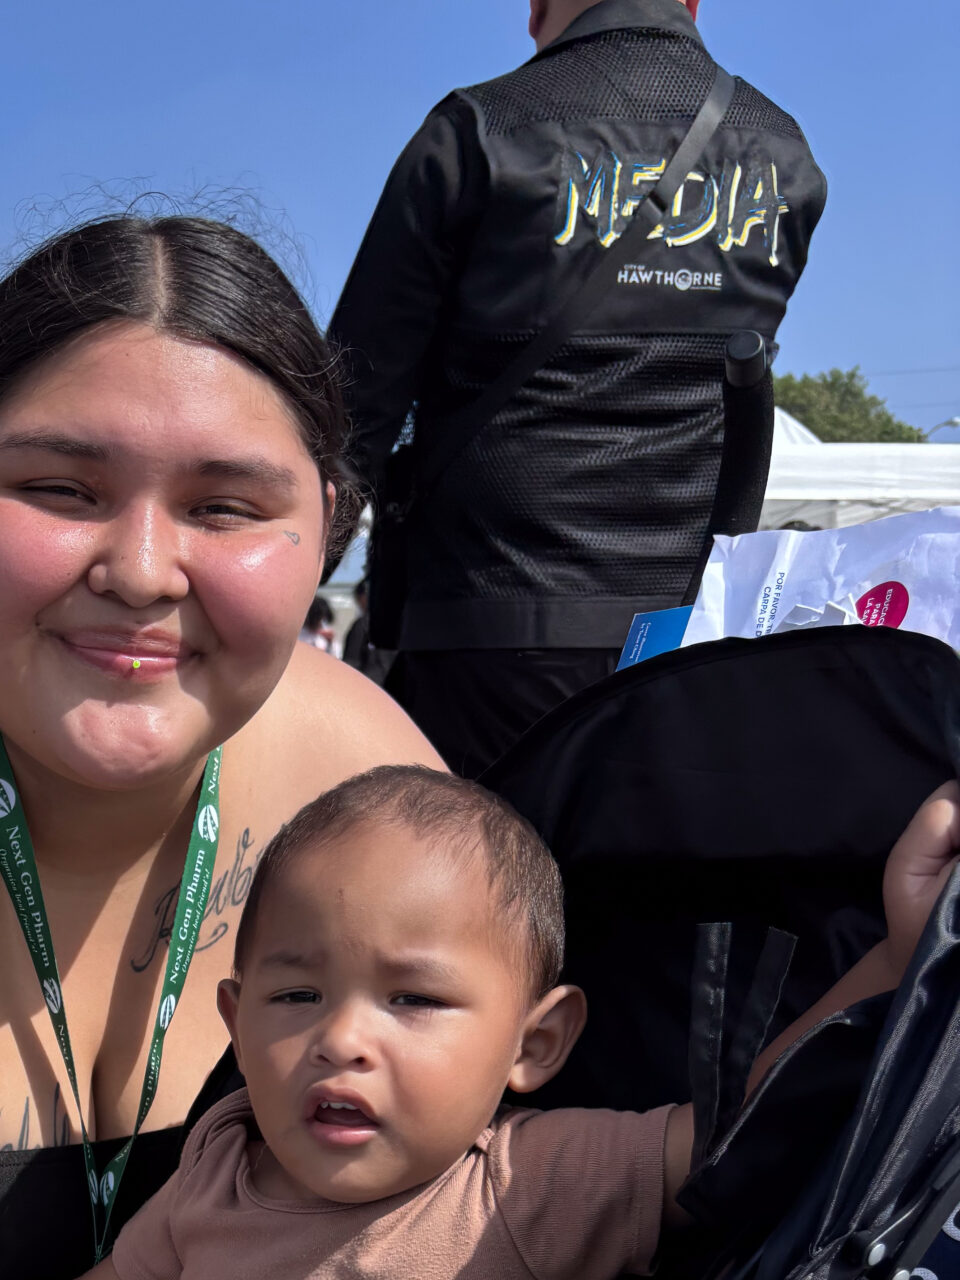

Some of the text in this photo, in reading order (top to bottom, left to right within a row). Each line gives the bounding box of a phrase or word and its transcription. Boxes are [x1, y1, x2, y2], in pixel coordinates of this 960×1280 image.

[553, 150, 790, 268] MEDIA
[617, 269, 723, 291] HAWTHORNE
[775, 572, 785, 591] POR
[759, 586, 771, 615] CARPA
[865, 597, 875, 608] LA
[756, 617, 765, 629] DE
[868, 603, 881, 625] PARA
[208, 756, 219, 796] Next
[6, 825, 50, 967] Next Gen Pharm
[169, 849, 206, 984] Next Gen Pharm
